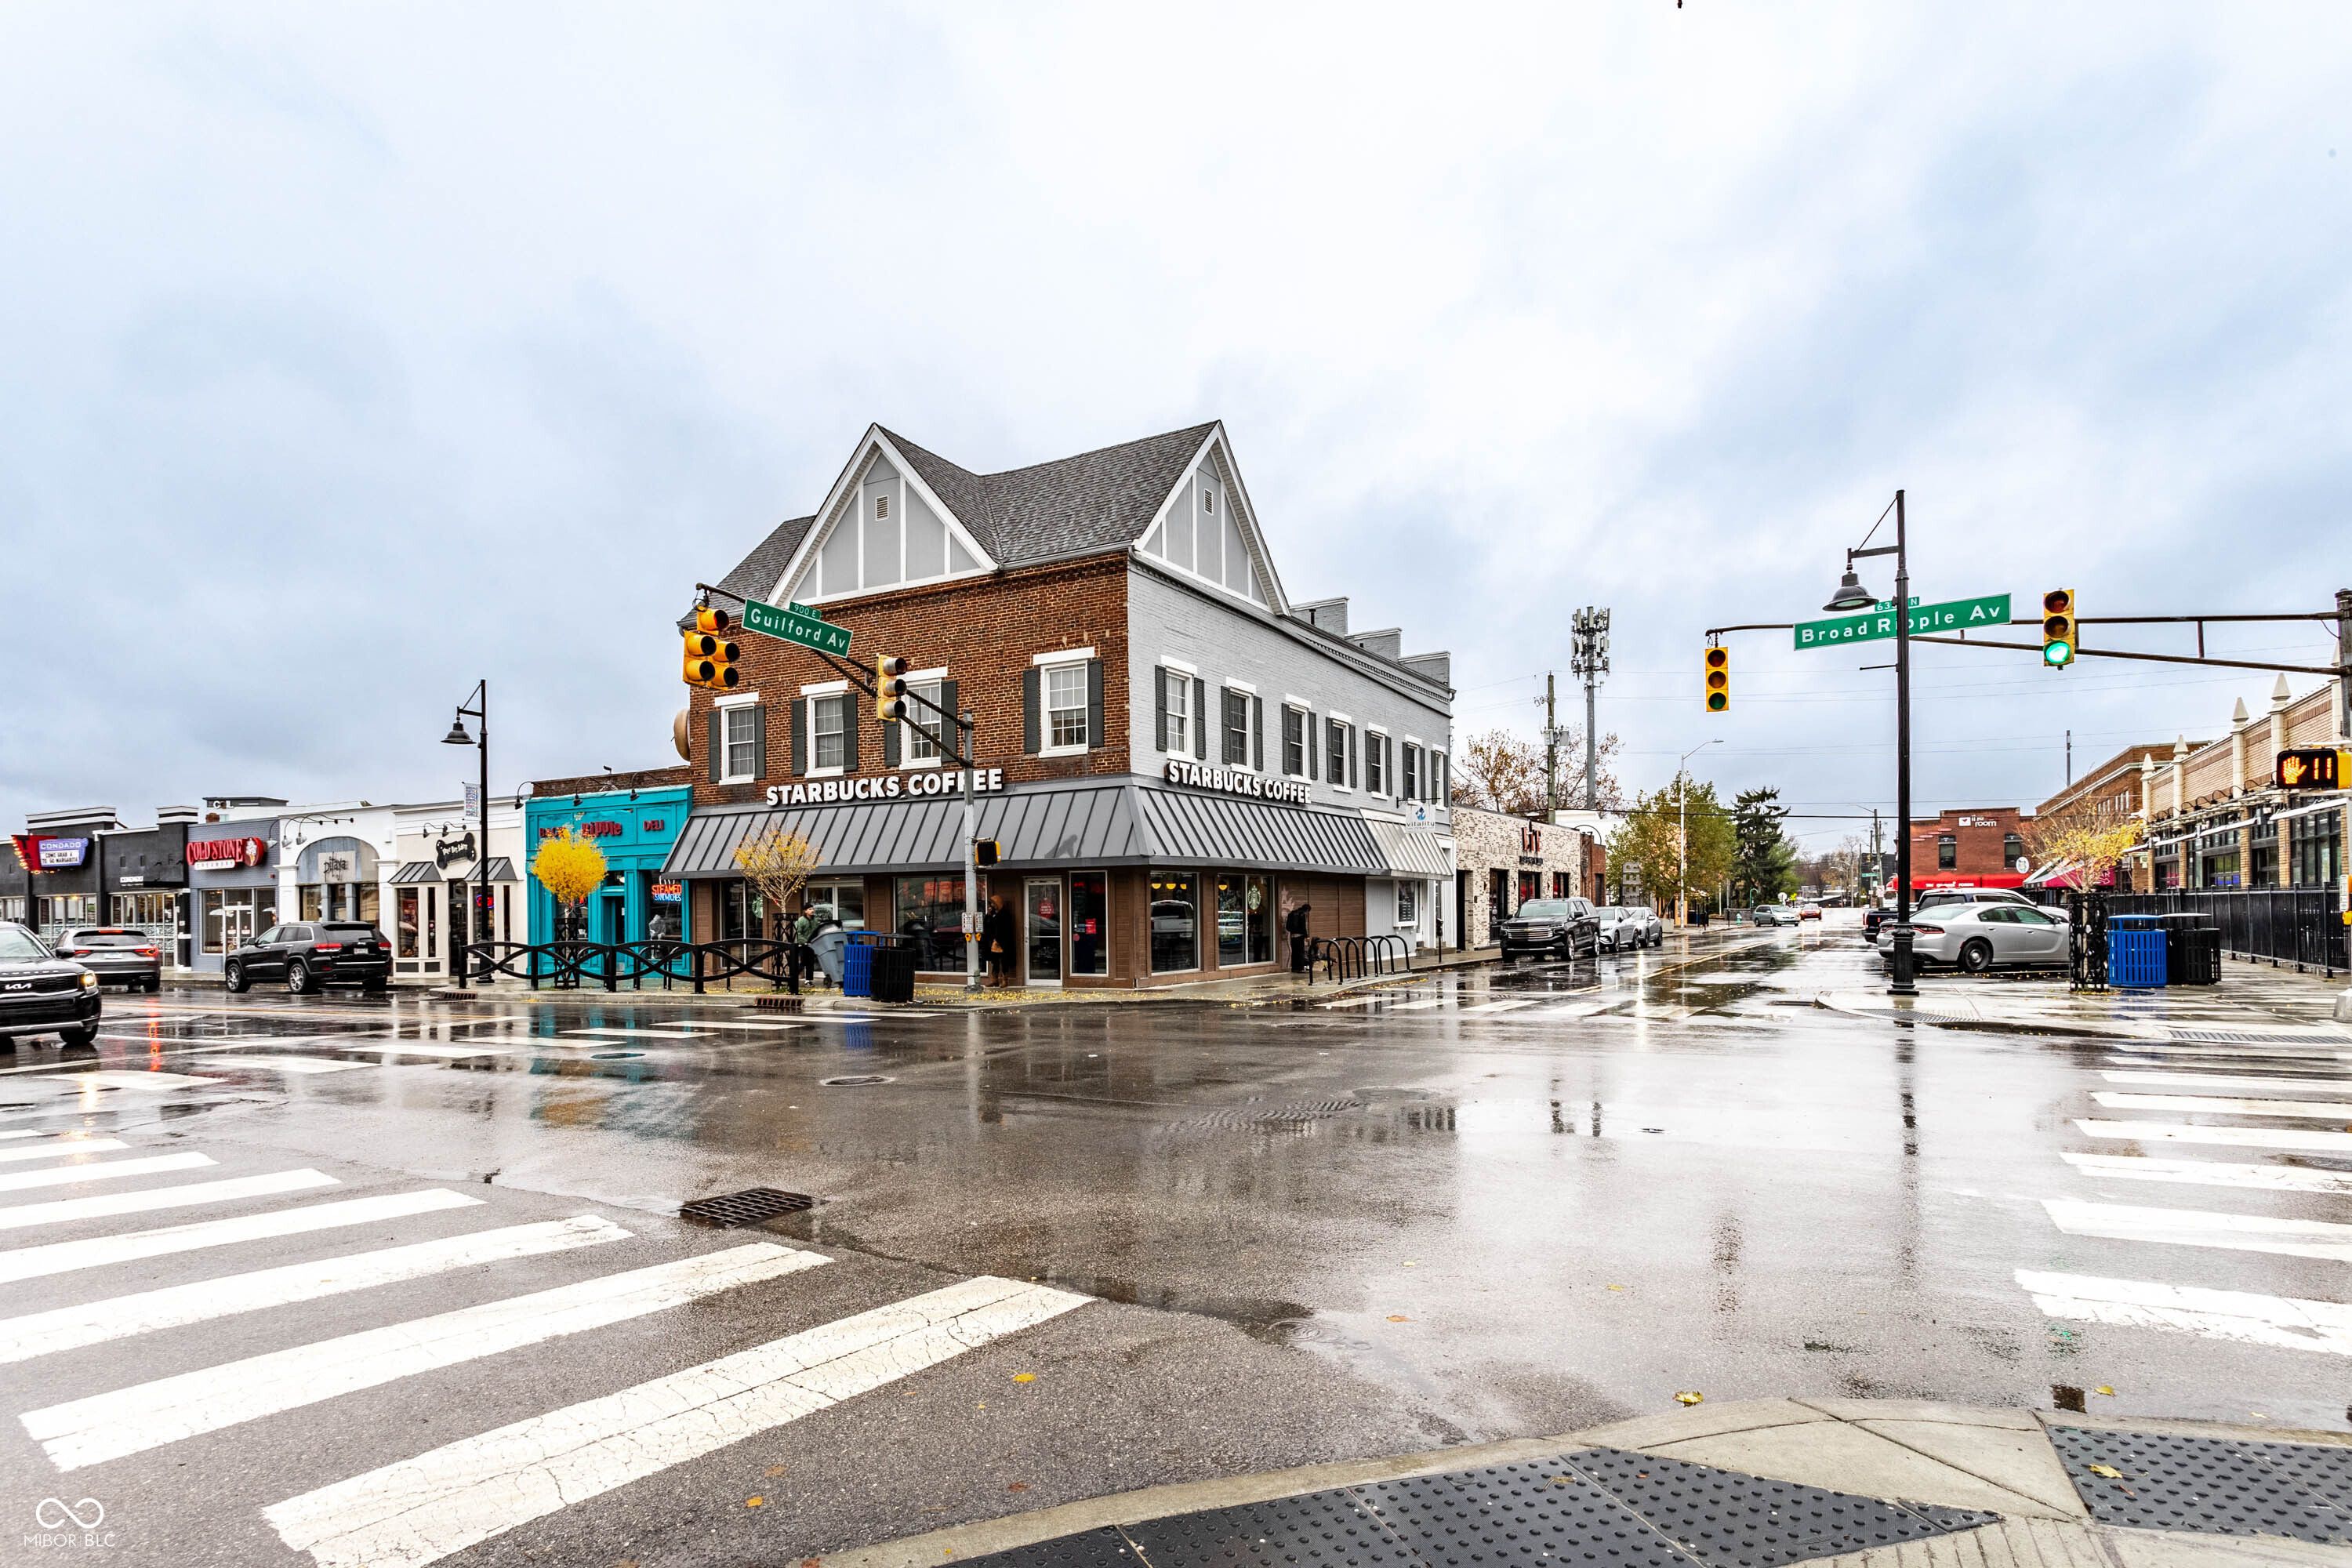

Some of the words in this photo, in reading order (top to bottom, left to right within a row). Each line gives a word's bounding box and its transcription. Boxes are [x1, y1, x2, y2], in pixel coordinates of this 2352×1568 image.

[794, 604, 809, 615] 900
[1877, 602, 1897, 611] 63
[750, 608, 822, 641] Guilford
[827, 632, 845, 648] Av
[1802, 622, 1867, 643] Broad
[1969, 605, 2000, 620] Av
[2314, 757, 2332, 780] 11
[766, 775, 901, 806] STARBUCKS
[1168, 760, 1261, 797] STARBUCKS
[1265, 779, 1312, 804] COFFEE
[643, 819, 664, 831] DELI
[40, 841, 82, 850] CONDADO
[187, 842, 210, 866] COLD
[212, 839, 243, 862] STONE
[652, 884, 682, 895] STEAMED
